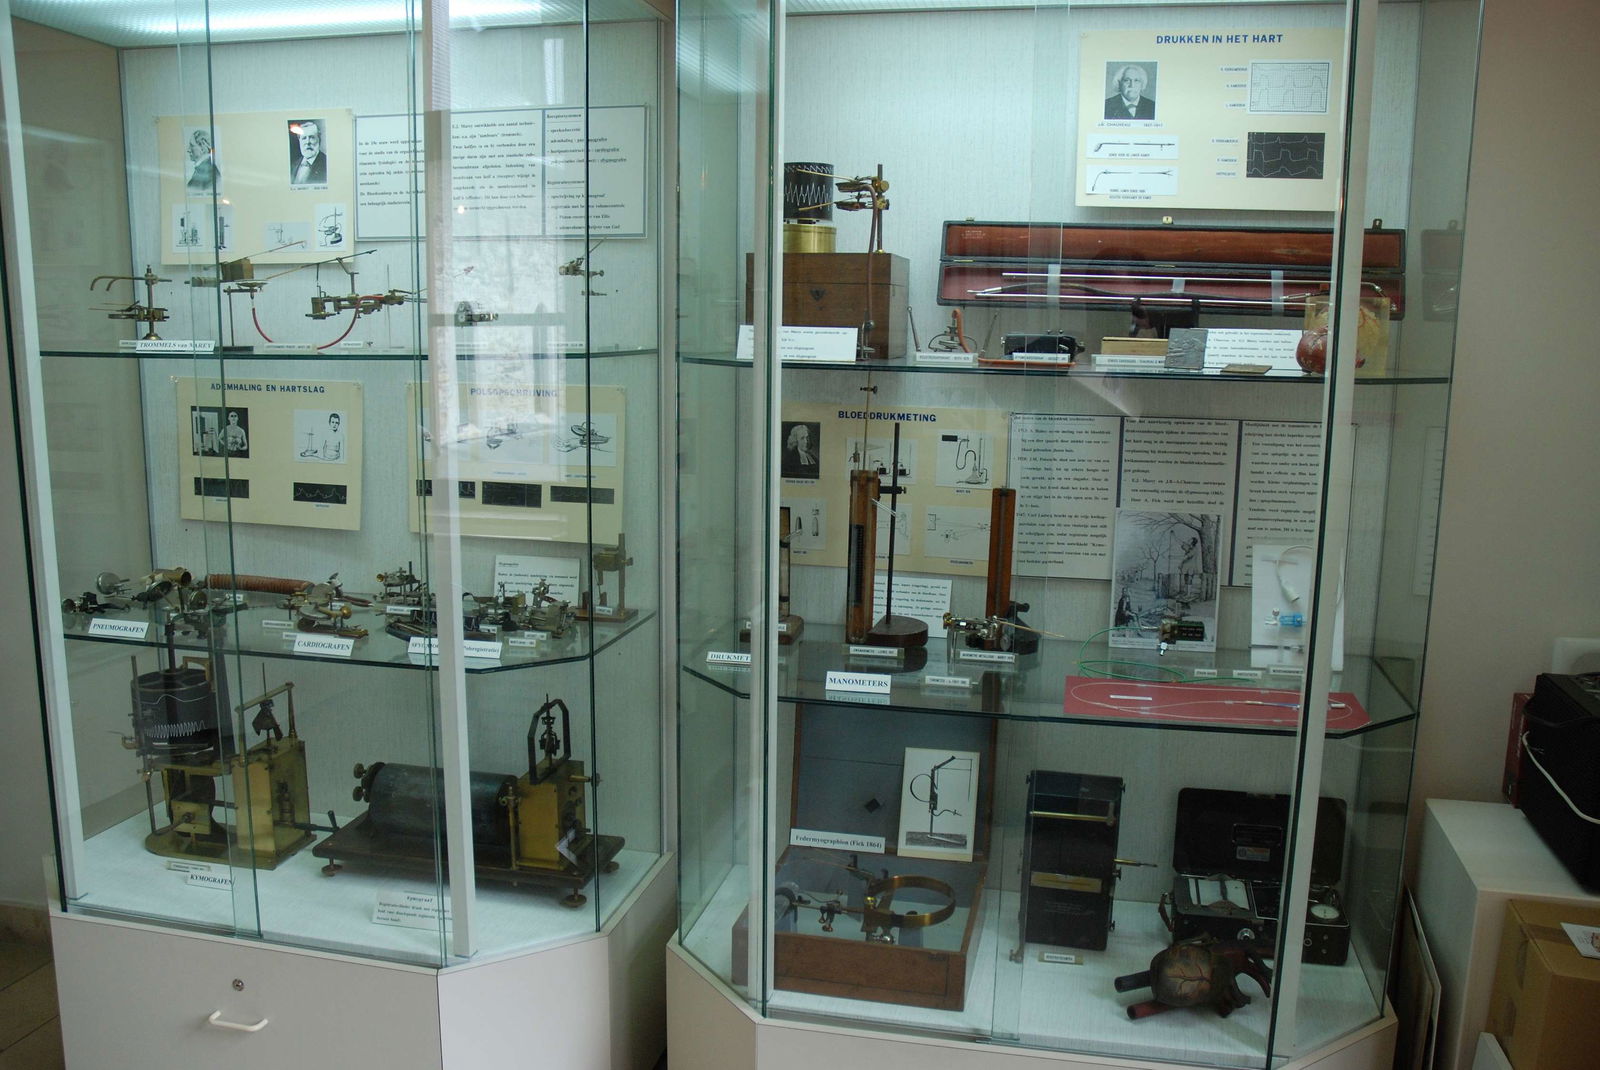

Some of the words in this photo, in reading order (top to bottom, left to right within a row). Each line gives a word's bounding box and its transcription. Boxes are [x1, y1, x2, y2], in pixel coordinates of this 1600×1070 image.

[1156, 34, 1209, 44] DRUKKEN
[1212, 34, 1222, 44] IN
[1226, 34, 1248, 44] HET
[1252, 34, 1283, 43] HART
[211, 383, 262, 391] ADEMHALING
[280, 385, 325, 393] HARTSLAG
[838, 411, 936, 422] BLOEDDRUKMETING
[92, 623, 144, 633] PNEUMOGRAFEN
[297, 640, 350, 650] CARDIOGRAFEN
[829, 677, 888, 688] MANOMETERS
[190, 874, 232, 885] KYMOGRAFEN
